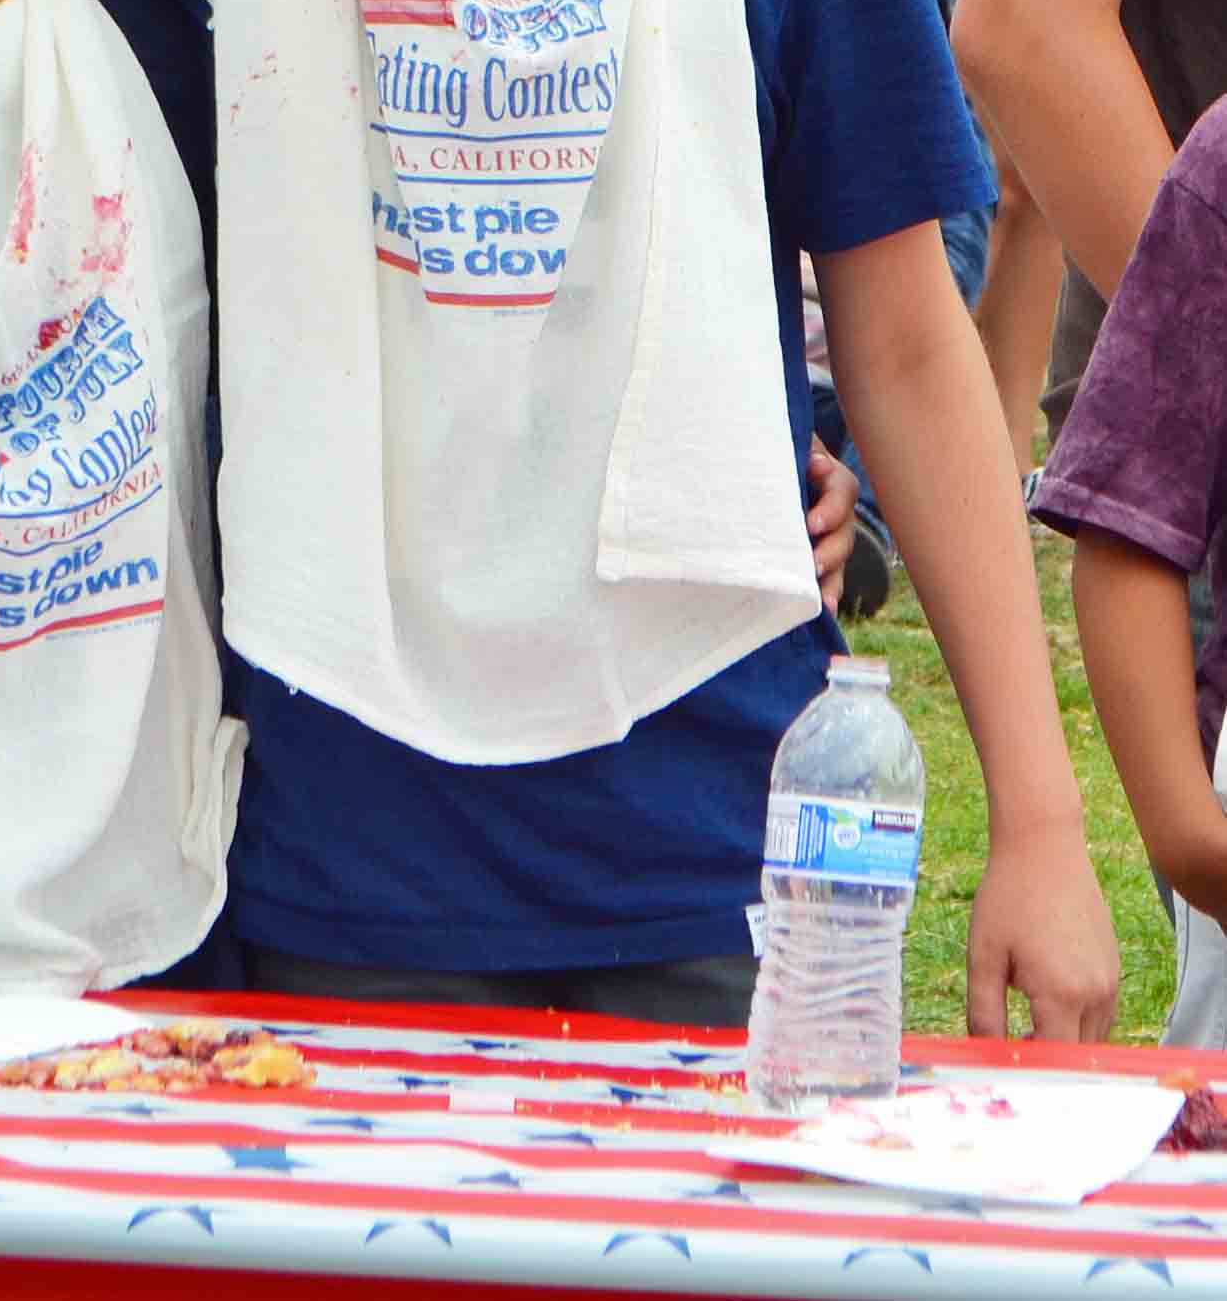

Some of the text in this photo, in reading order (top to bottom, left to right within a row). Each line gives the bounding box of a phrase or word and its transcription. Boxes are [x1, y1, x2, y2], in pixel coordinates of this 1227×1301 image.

[429, 146, 599, 172] CALIFORN
[474, 199, 560, 242] pie
[9, 329, 145, 458] OF JULY
[21, 461, 163, 545] CALIFORNIA
[32, 554, 160, 619] down
[43, 539, 105, 592] pie
